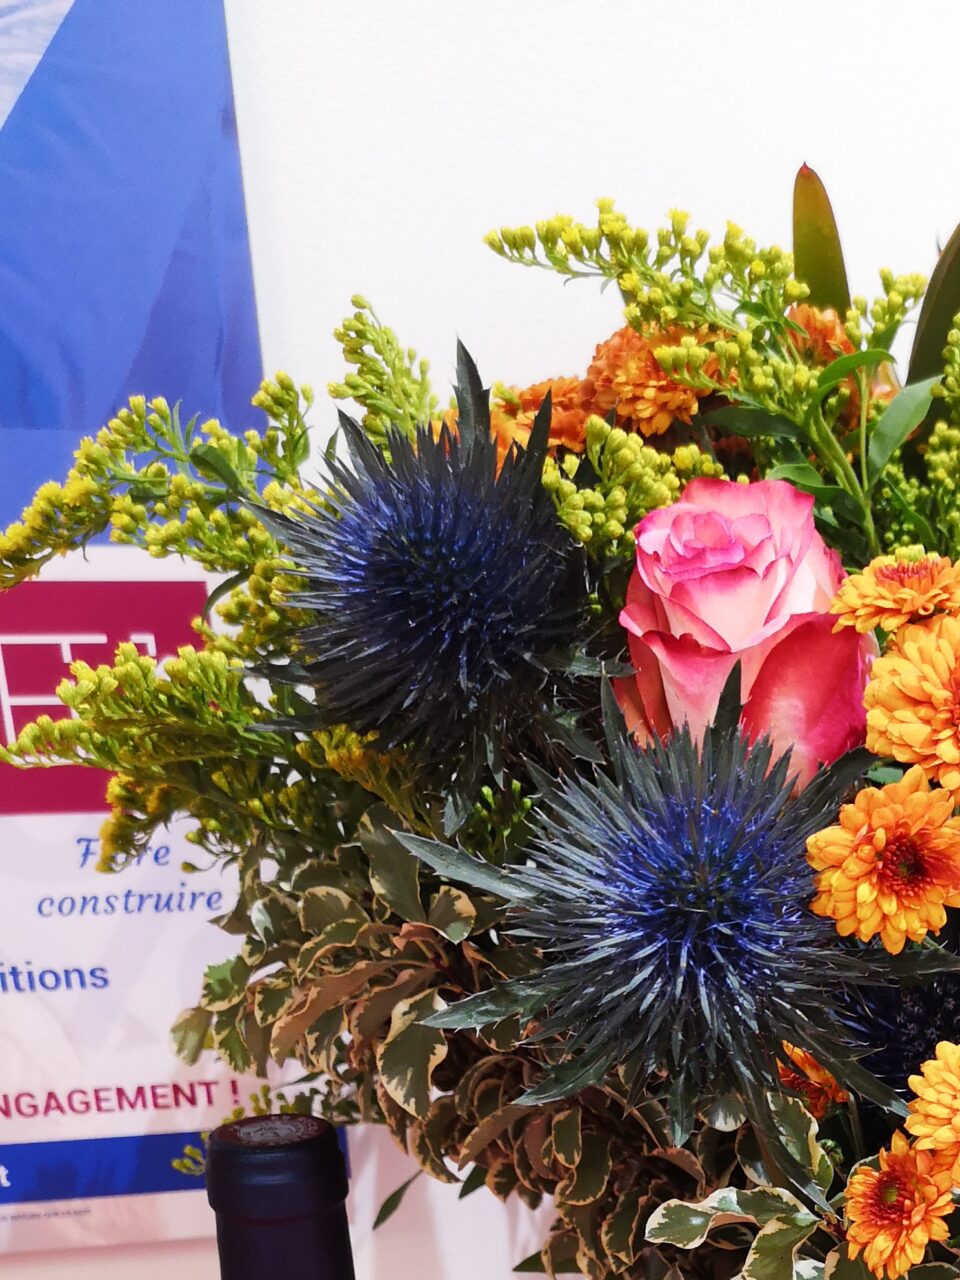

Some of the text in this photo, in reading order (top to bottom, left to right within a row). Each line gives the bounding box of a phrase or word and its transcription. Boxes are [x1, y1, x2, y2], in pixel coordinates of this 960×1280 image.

[76, 836, 171, 868] Fre
[37, 881, 223, 918] construire
[0, 960, 110, 993] itions
[230, 1080, 240, 1104] !
